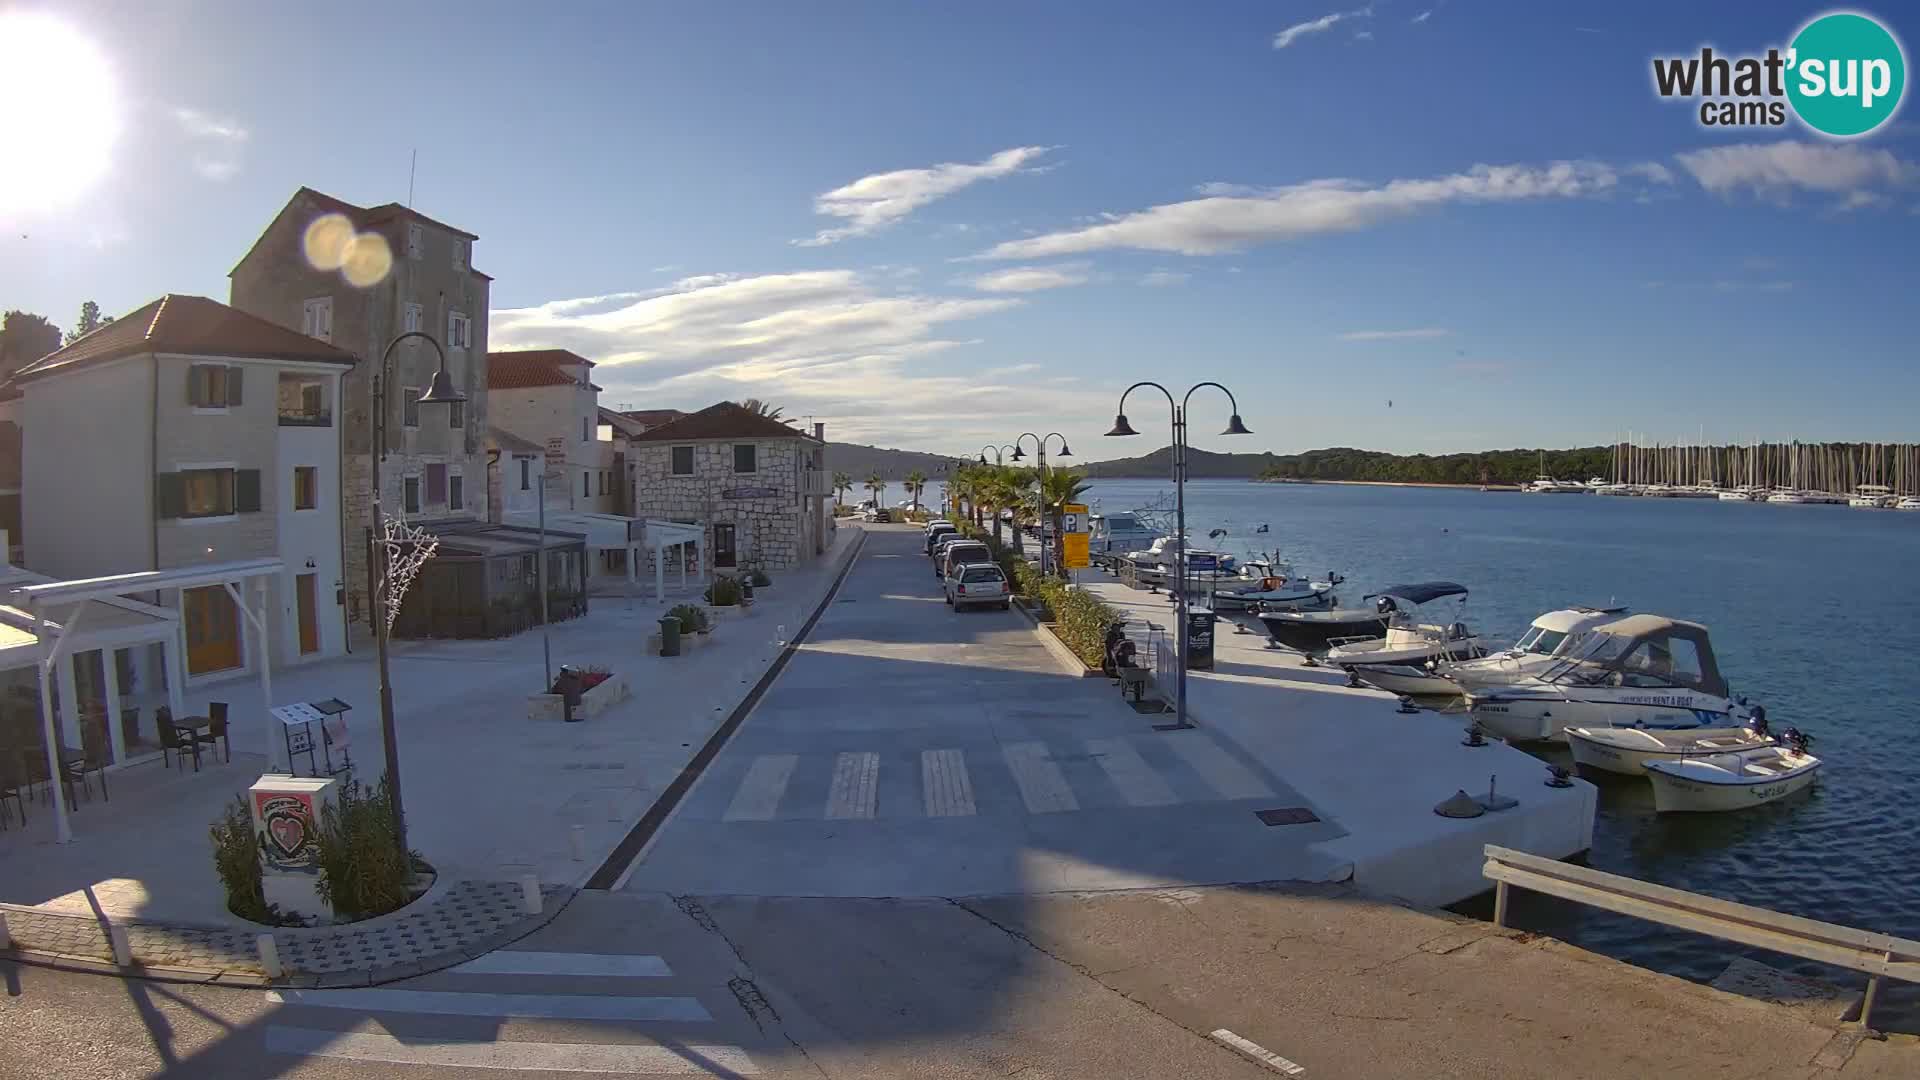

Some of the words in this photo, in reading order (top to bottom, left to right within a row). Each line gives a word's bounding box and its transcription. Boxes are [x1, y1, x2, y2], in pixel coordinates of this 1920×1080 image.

[1065, 515, 1076, 531] P
[1652, 695, 1670, 705] RENT
[1676, 696, 1693, 706] BOAT
